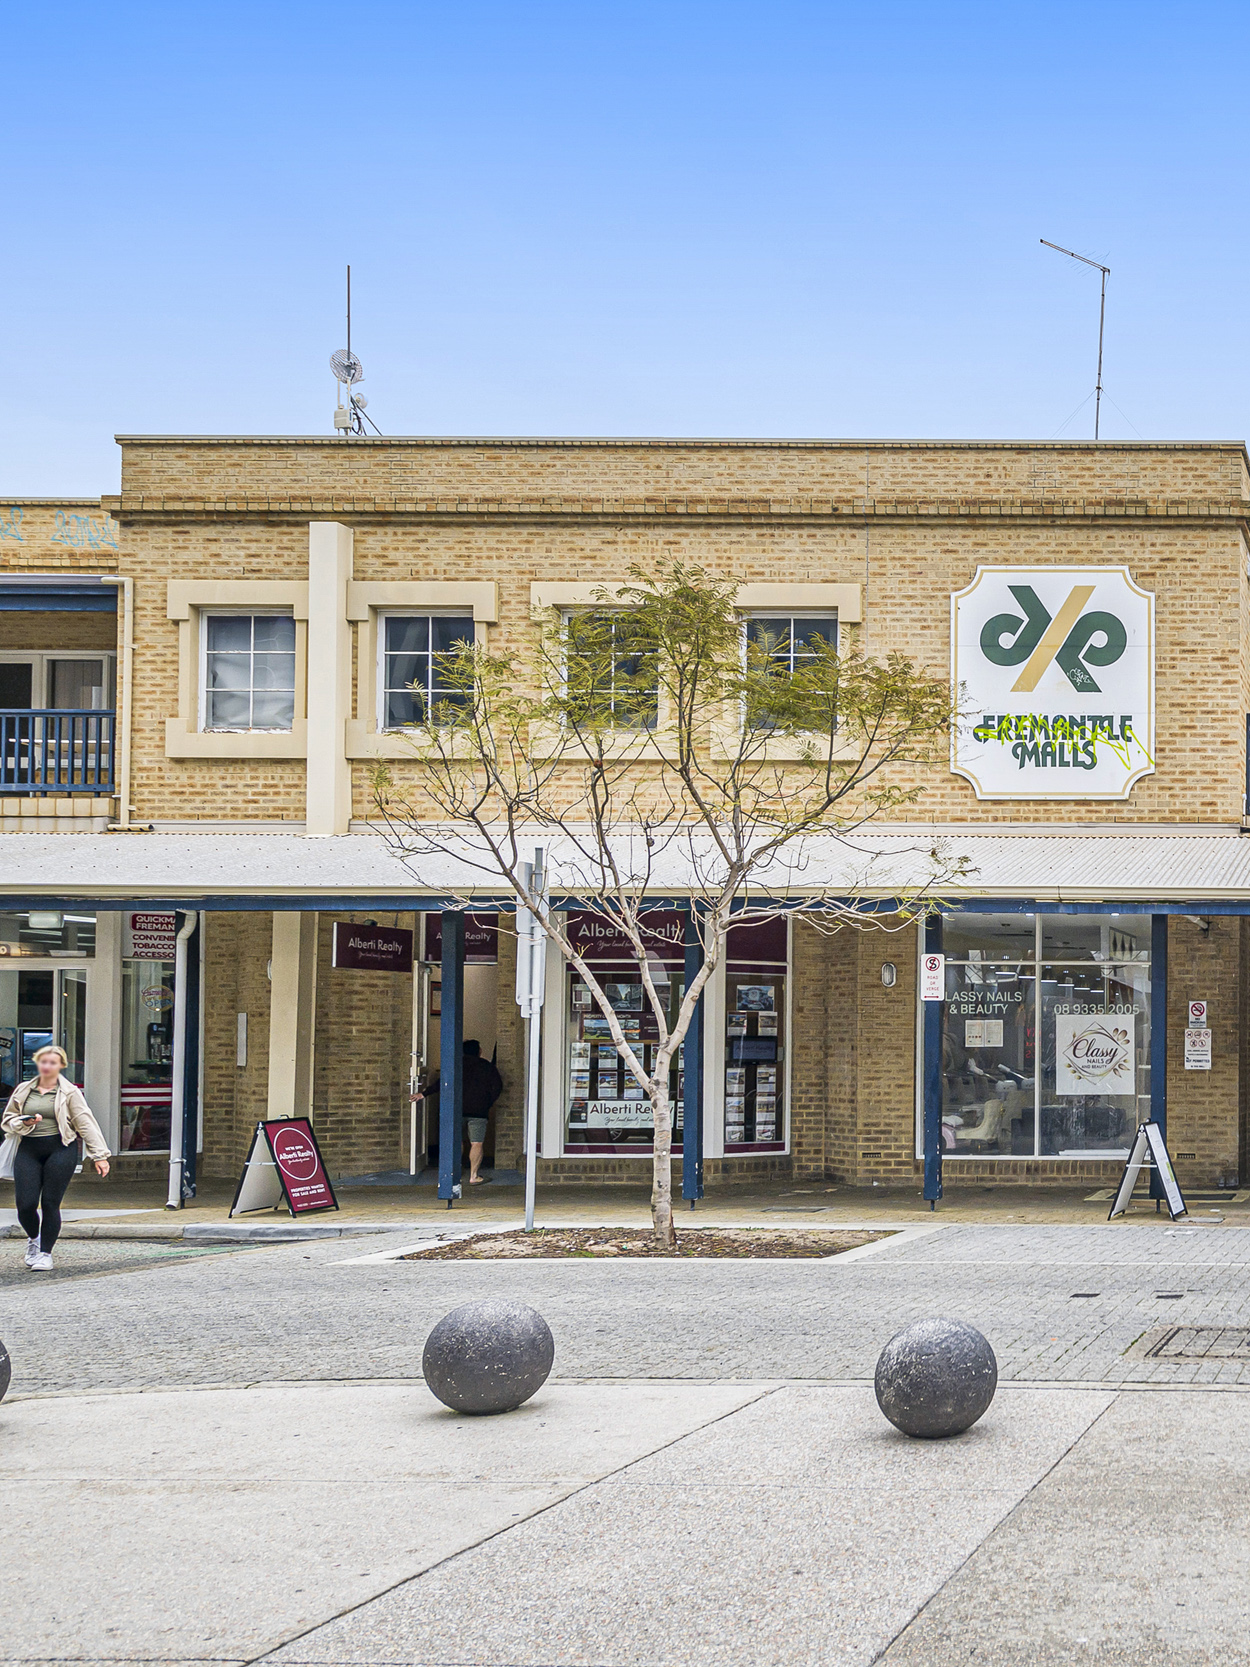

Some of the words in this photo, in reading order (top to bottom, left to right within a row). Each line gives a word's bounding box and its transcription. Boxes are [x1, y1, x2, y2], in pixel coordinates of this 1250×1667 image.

[972, 714, 1133, 744] FREMANTLE
[1011, 740, 1098, 770] MALLS
[136, 915, 175, 923] QUICKM
[578, 923, 627, 937] Alber
[465, 931, 491, 942] Realty
[132, 942, 175, 950] TOBACCO
[348, 937, 376, 950] Alberti
[377, 939, 403, 955] Realty
[132, 950, 175, 958] ACCESSO
[945, 991, 983, 1002] LASSY
[986, 991, 1022, 1002] NAILS
[949, 1004, 958, 1014] &
[960, 1004, 1008, 1014] BEAUTY
[1054, 1003, 1070, 1015] 08
[1073, 1003, 1105, 1015] 9335
[1108, 1003, 1140, 1015] 2005
[1072, 1037, 1118, 1064] Classy
[589, 1103, 632, 1114] Alberti
[279, 1151, 298, 1160] Alberti
[297, 1150, 314, 1158] Realty
